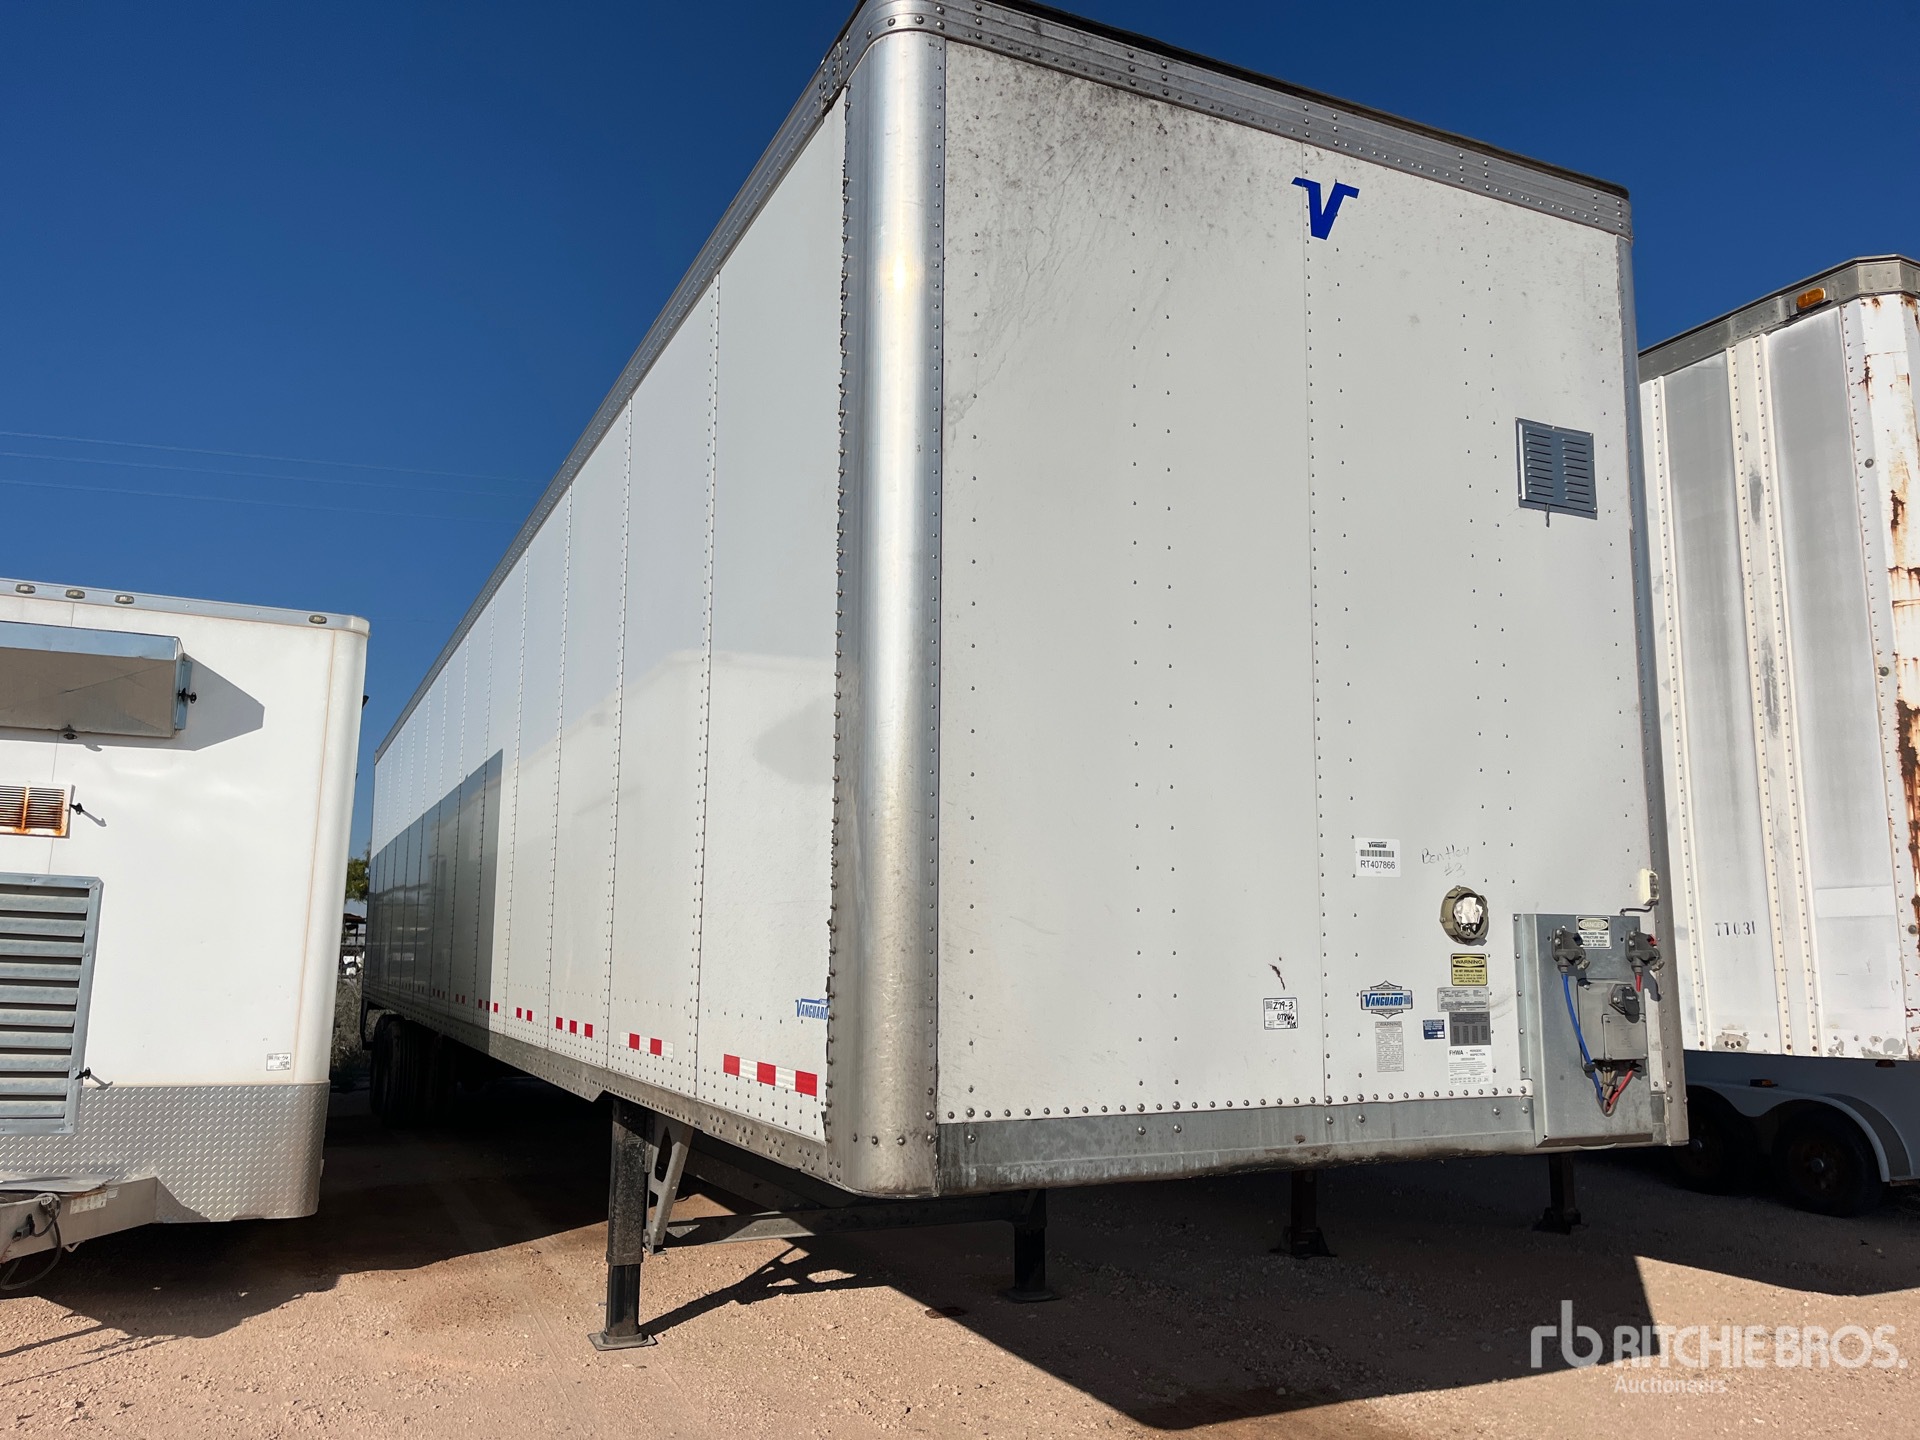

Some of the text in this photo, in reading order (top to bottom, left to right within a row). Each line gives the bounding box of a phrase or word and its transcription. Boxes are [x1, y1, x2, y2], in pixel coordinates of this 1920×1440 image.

[1291, 177, 1360, 240] V
[1360, 860, 1396, 869] RT407866
[1363, 992, 1403, 1007] VANGUARD
